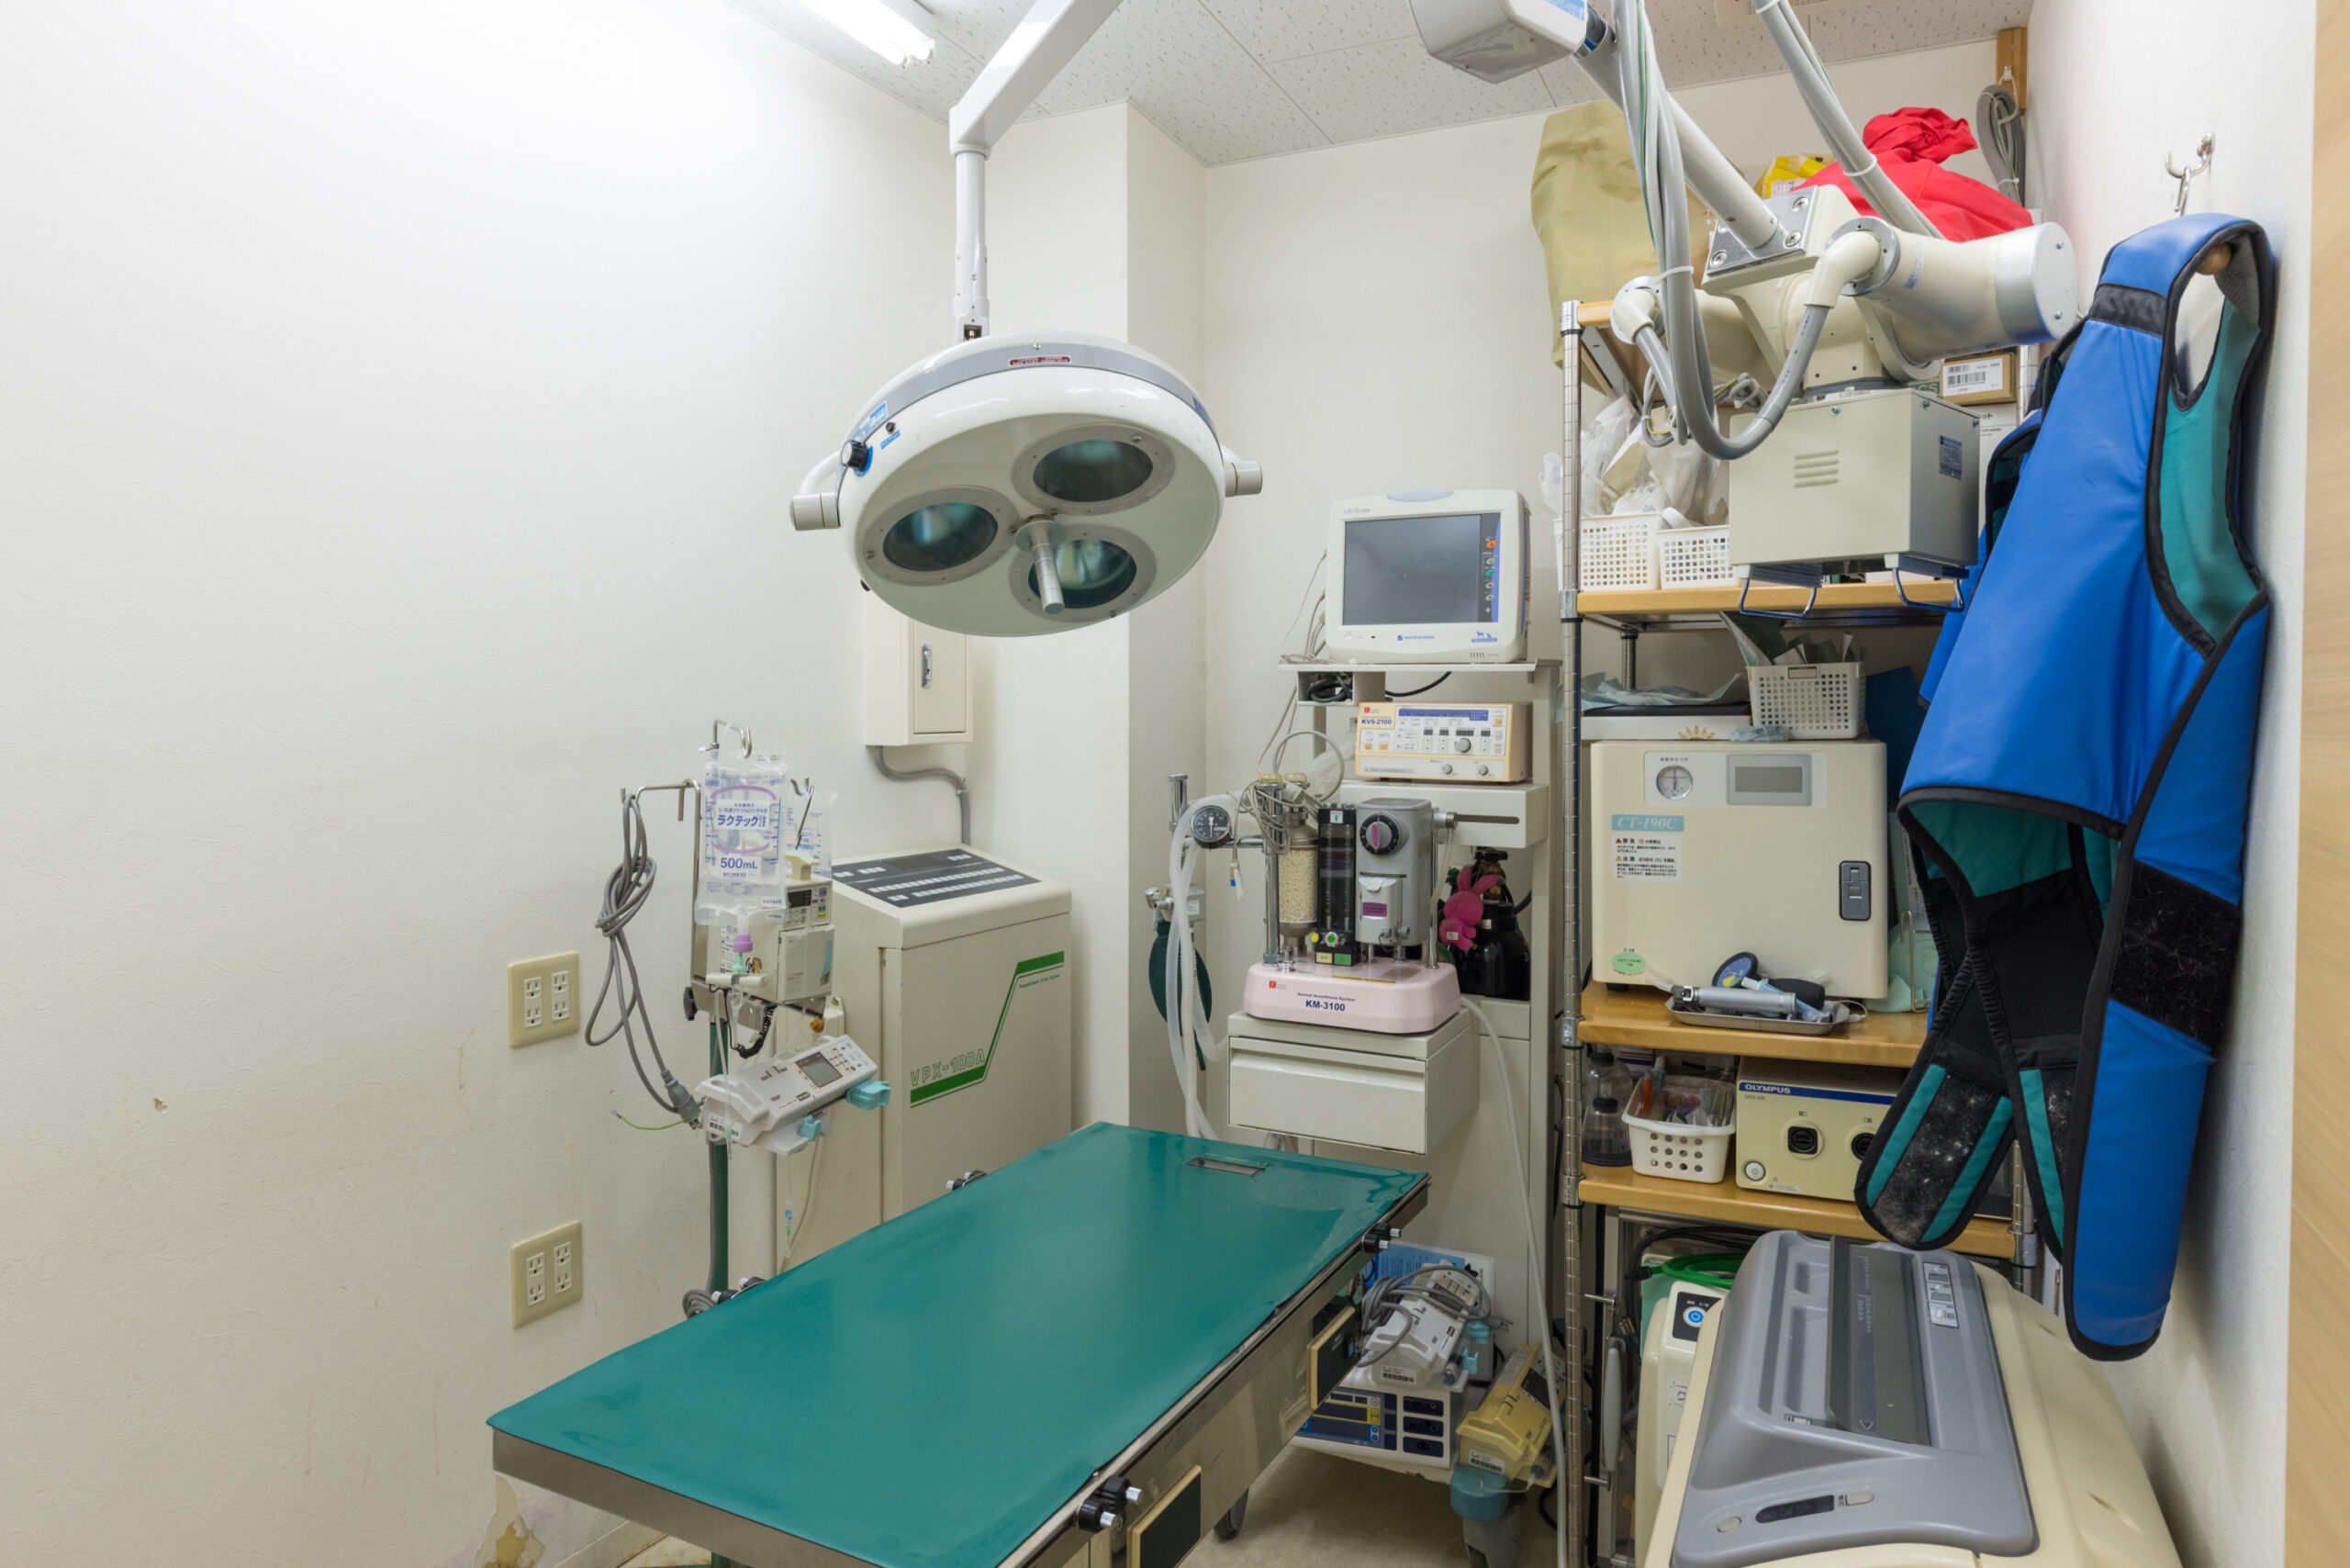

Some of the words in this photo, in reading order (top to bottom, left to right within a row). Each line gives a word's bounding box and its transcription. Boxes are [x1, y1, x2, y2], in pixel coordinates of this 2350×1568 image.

[717, 814, 766, 827] ラクテック注
[1617, 816, 1677, 829] CT-190C
[720, 857, 758, 869] 500mL
[1305, 1000, 1346, 1012] KM-3100
[910, 1048, 986, 1087] VPX-100A
[1744, 1083, 1791, 1094] OLYMPUS
